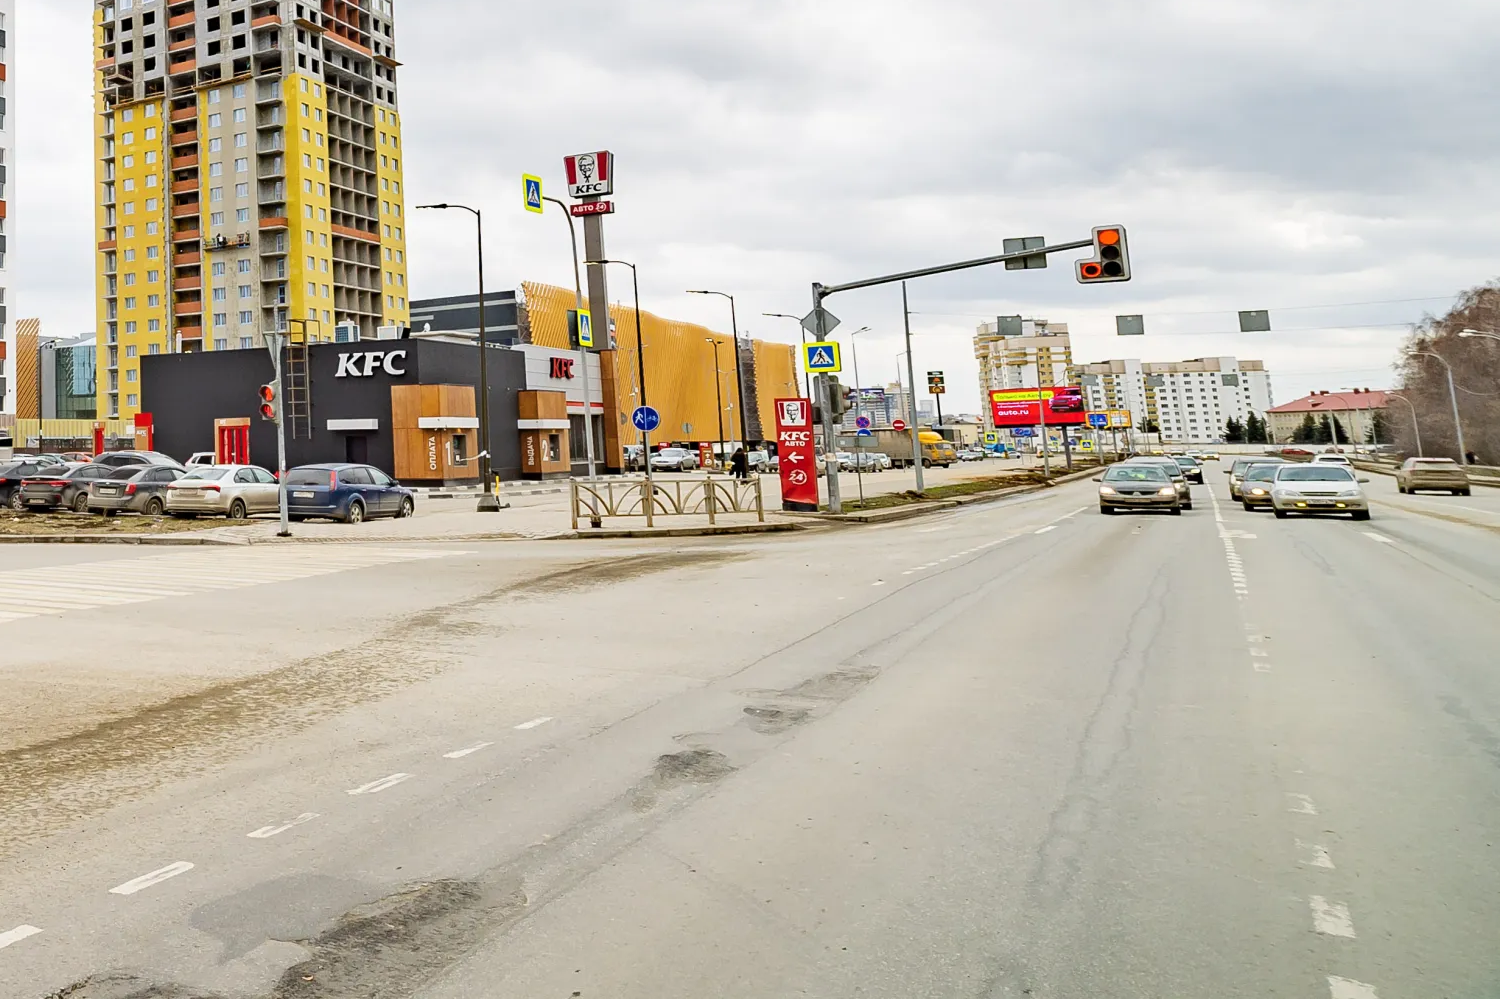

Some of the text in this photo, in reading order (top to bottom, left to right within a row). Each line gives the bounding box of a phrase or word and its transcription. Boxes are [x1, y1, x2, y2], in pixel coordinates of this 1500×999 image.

[575, 183, 602, 194] KFC
[573, 205, 594, 213] АВТО
[334, 350, 407, 377] KFC
[550, 357, 574, 379] KFC
[780, 431, 810, 441] KFC
[429, 436, 437, 470] ОПЛАТА
[445, 441, 451, 466] 1
[542, 439, 549, 461] 2
